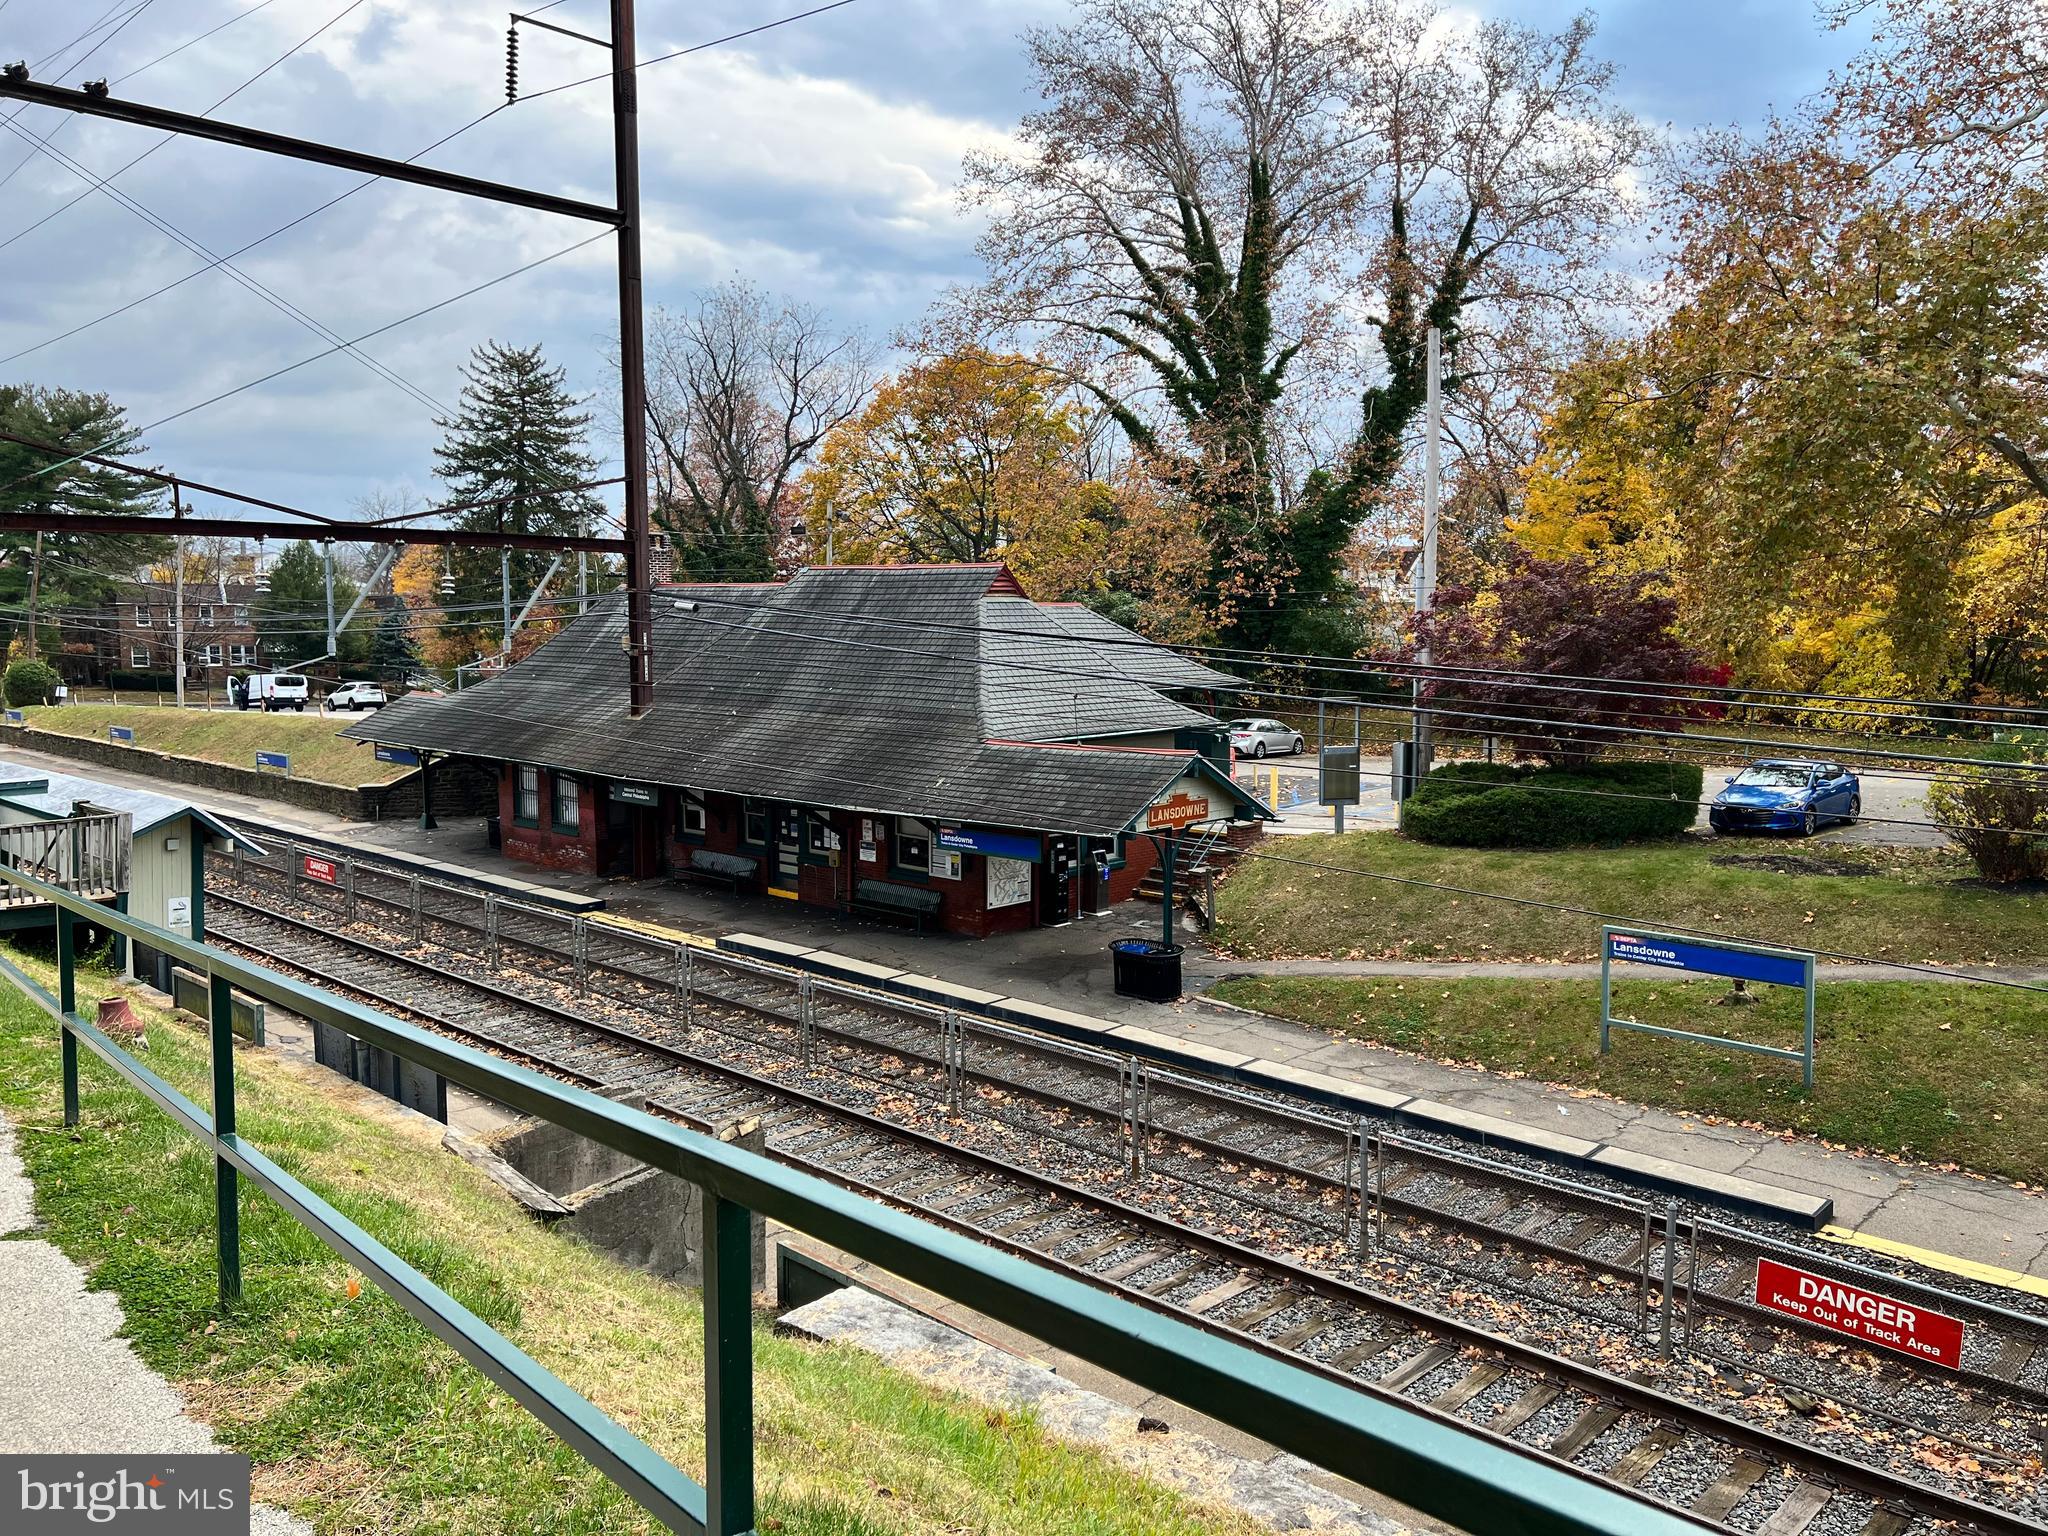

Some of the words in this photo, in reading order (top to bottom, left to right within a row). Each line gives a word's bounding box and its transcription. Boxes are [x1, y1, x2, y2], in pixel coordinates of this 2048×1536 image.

[1151, 803, 1206, 822] LANSDOWNE
[940, 833, 974, 845] Lansdowne
[310, 860, 329, 874] DANGER
[1613, 941, 1676, 959] Lansdowne
[1657, 957, 1685, 967] Philadelphia
[1799, 1276, 1916, 1332] DANGER
[1773, 1292, 1808, 1313] Keep
[1813, 1306, 1838, 1323] Out
[1843, 1318, 1859, 1330] of
[1863, 1321, 1901, 1344] Track
[1906, 1337, 1941, 1357] Area
